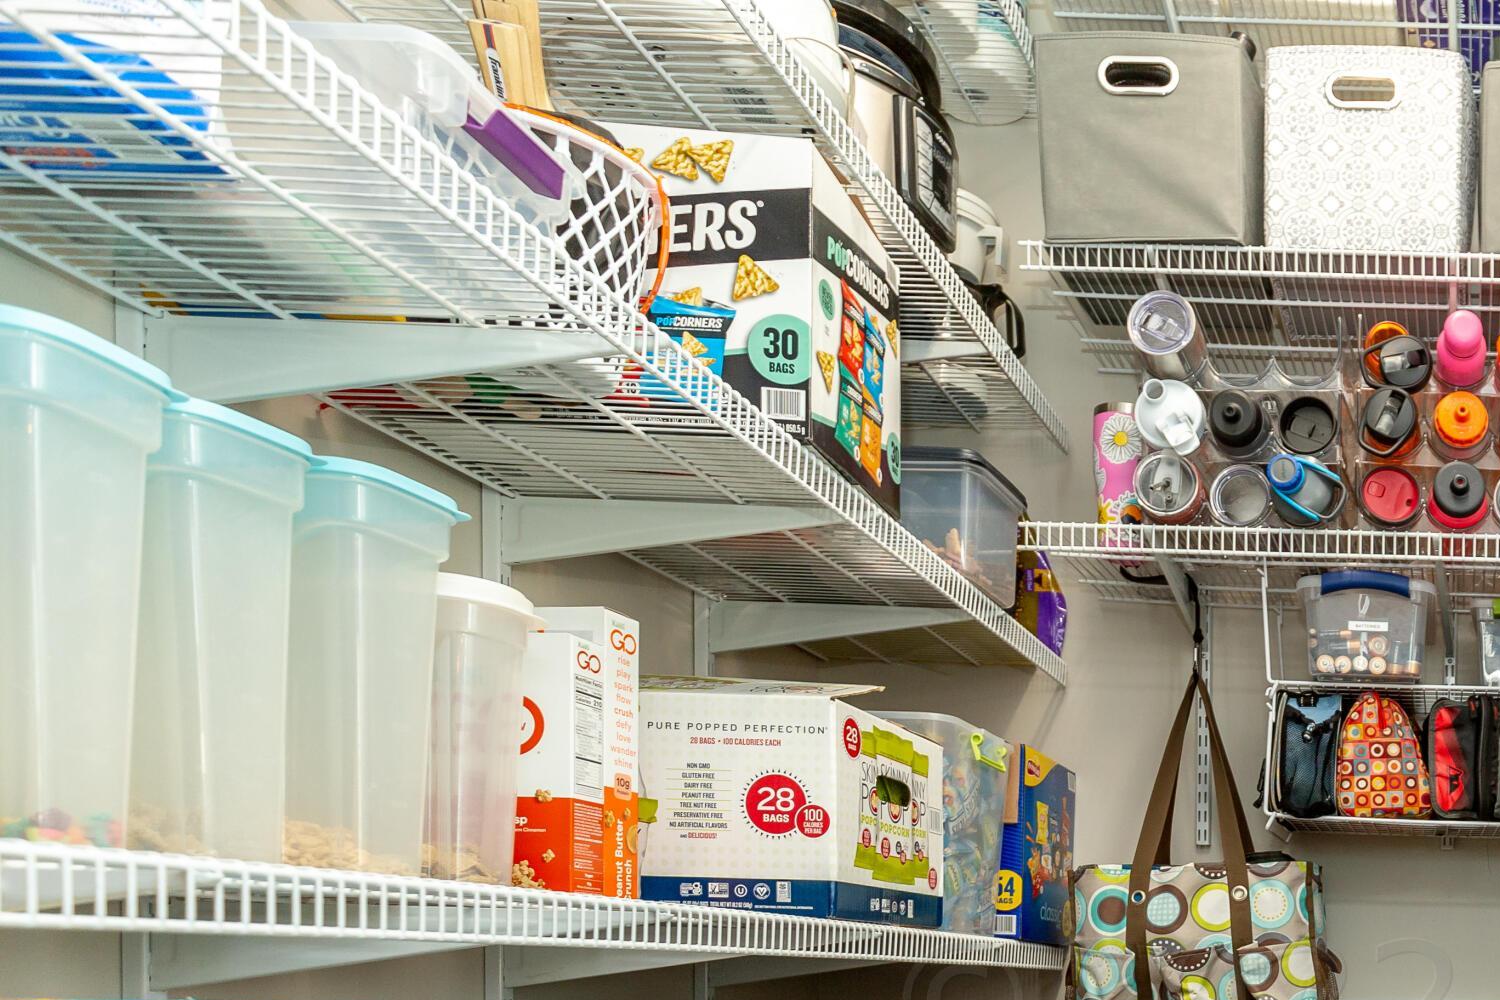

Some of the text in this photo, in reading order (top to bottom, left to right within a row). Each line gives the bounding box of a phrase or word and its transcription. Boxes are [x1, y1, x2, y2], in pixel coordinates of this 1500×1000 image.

[763, 327, 799, 360] 30
[769, 362, 795, 375] BAGS
[614, 707, 634, 719] crush
[647, 721, 829, 735] PURE POPPED PERFECTION
[846, 724, 858, 743] 28
[616, 732, 631, 744] love
[690, 736, 781, 747] 28 BAGS 100 CALORIES EACH
[610, 744, 637, 757] wander
[702, 772, 715, 780] FREE
[616, 776, 630, 790] 10g
[757, 786, 795, 812] 28
[673, 811, 710, 819] PRESERVATIVE
[763, 814, 790, 823] BAGS
[803, 809, 824, 822] 100
[803, 821, 824, 829] CALORIES
[880, 821, 910, 839] POPCORN
[615, 818, 624, 898] eanut Butter
